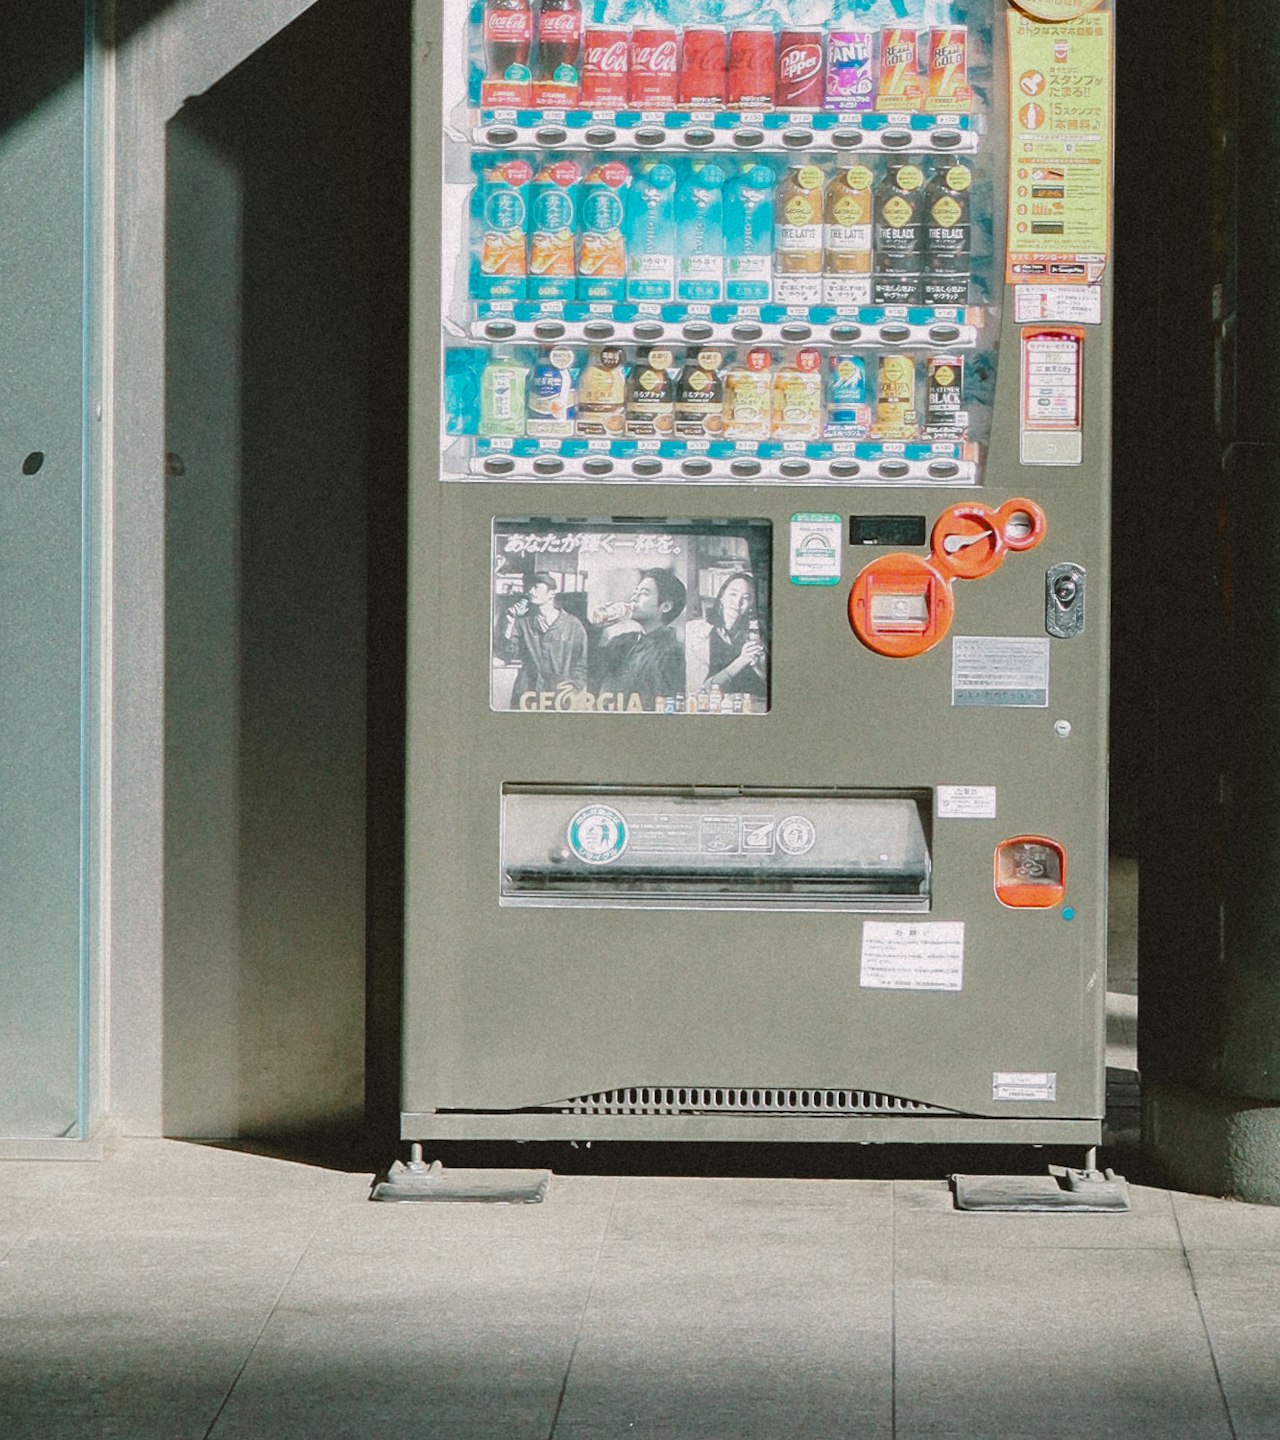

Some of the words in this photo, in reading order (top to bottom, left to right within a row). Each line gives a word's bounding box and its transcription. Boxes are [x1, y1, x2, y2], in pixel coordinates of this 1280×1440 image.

[489, 13, 527, 29] Coca-Cola
[789, 50, 807, 64] Dr
[1049, 75, 1103, 86] スタンプが
[892, 228, 915, 238] BLACK
[941, 228, 964, 238] BLACK
[929, 393, 961, 404] BLACK
[504, 533, 682, 555] あなたが輝く一杯を。
[520, 683, 643, 711] GEORGIA
